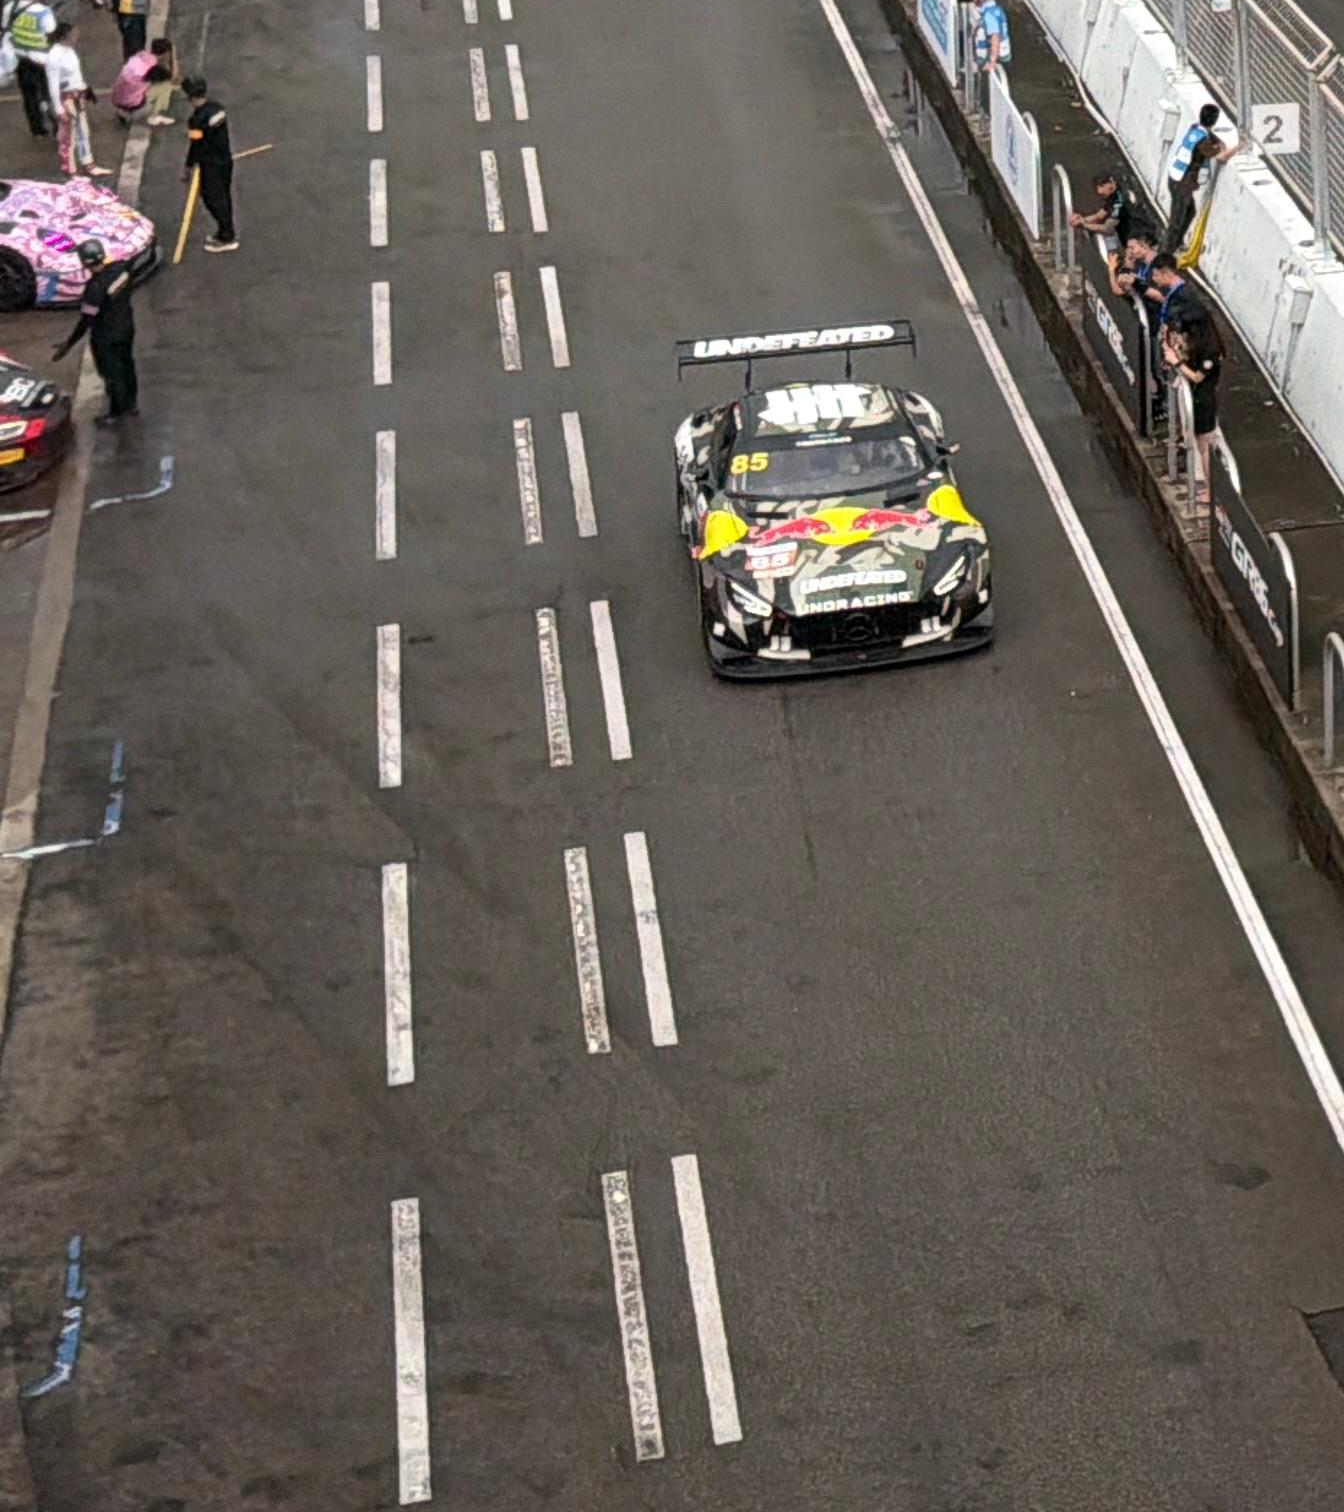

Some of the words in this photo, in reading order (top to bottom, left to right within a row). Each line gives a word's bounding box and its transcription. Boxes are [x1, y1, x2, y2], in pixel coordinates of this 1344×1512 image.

[1262, 115, 1284, 144] 2
[693, 324, 895, 359] UNDEFEATED
[731, 451, 770, 475] 85
[799, 569, 908, 595] UNDEFEATED
